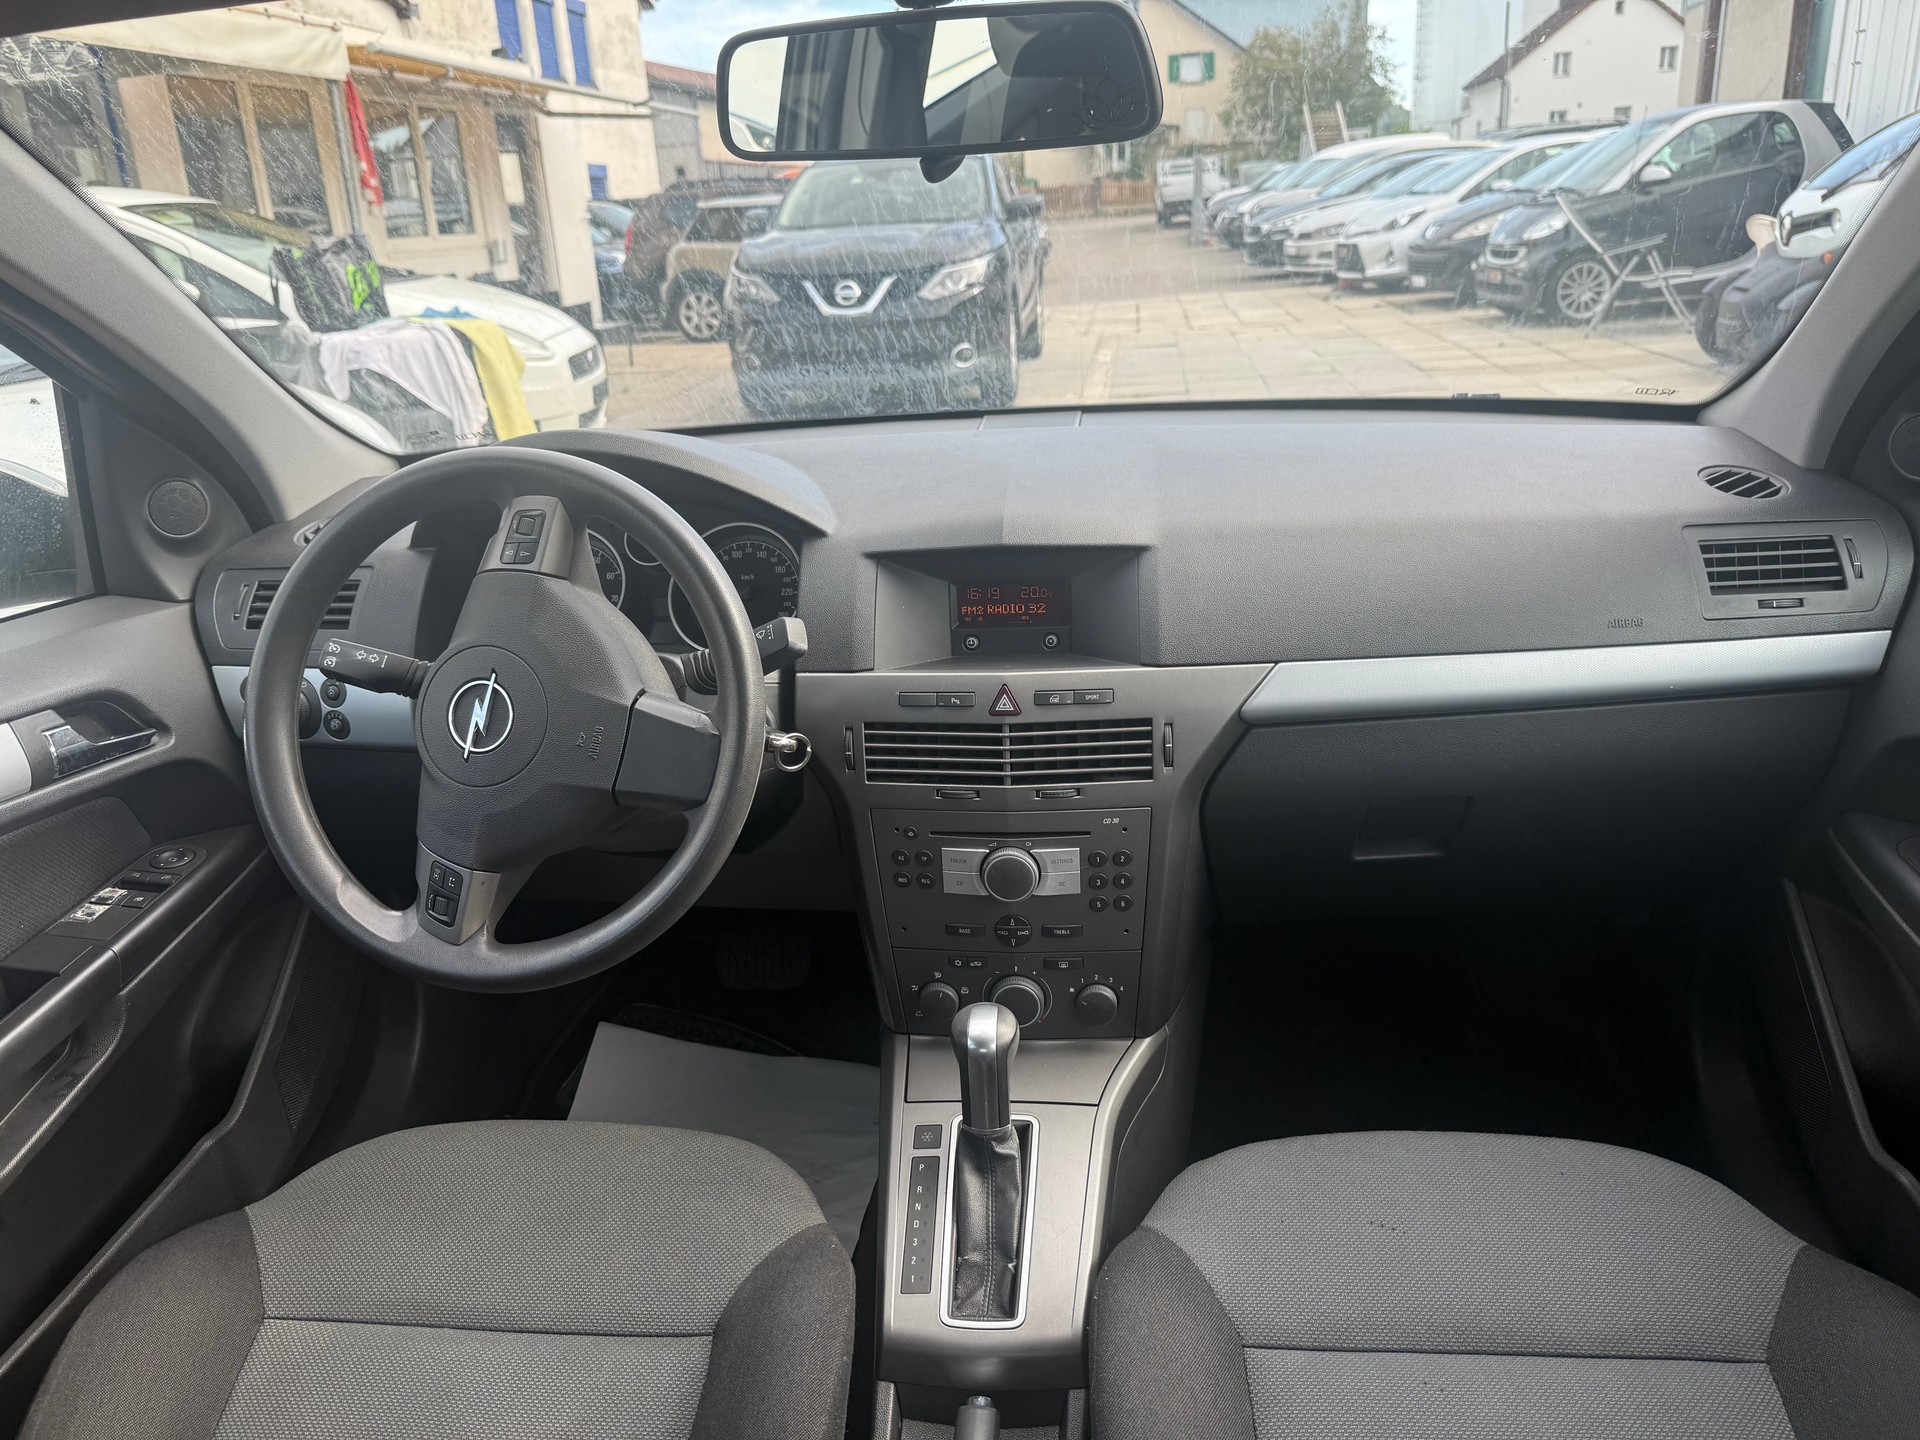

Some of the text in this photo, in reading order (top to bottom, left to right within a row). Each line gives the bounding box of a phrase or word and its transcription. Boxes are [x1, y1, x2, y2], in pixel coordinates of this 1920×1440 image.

[775, 566, 786, 574] 180
[606, 572, 615, 580] 60
[781, 588, 794, 596] 220
[967, 587, 1000, 600] 16:19
[611, 594, 619, 602] 70
[961, 603, 1046, 615] FM2 RADIO 32
[1607, 617, 1644, 629] AIRBAG
[588, 725, 604, 759] AIRBAG
[1050, 857, 1074, 865] SETTINGS
[919, 1163, 925, 1172] P
[916, 1185, 923, 1194] R
[914, 1202, 922, 1212] N
[913, 1219, 920, 1228] D
[912, 1237, 918, 1246] 3
[911, 1256, 916, 1265] 2
